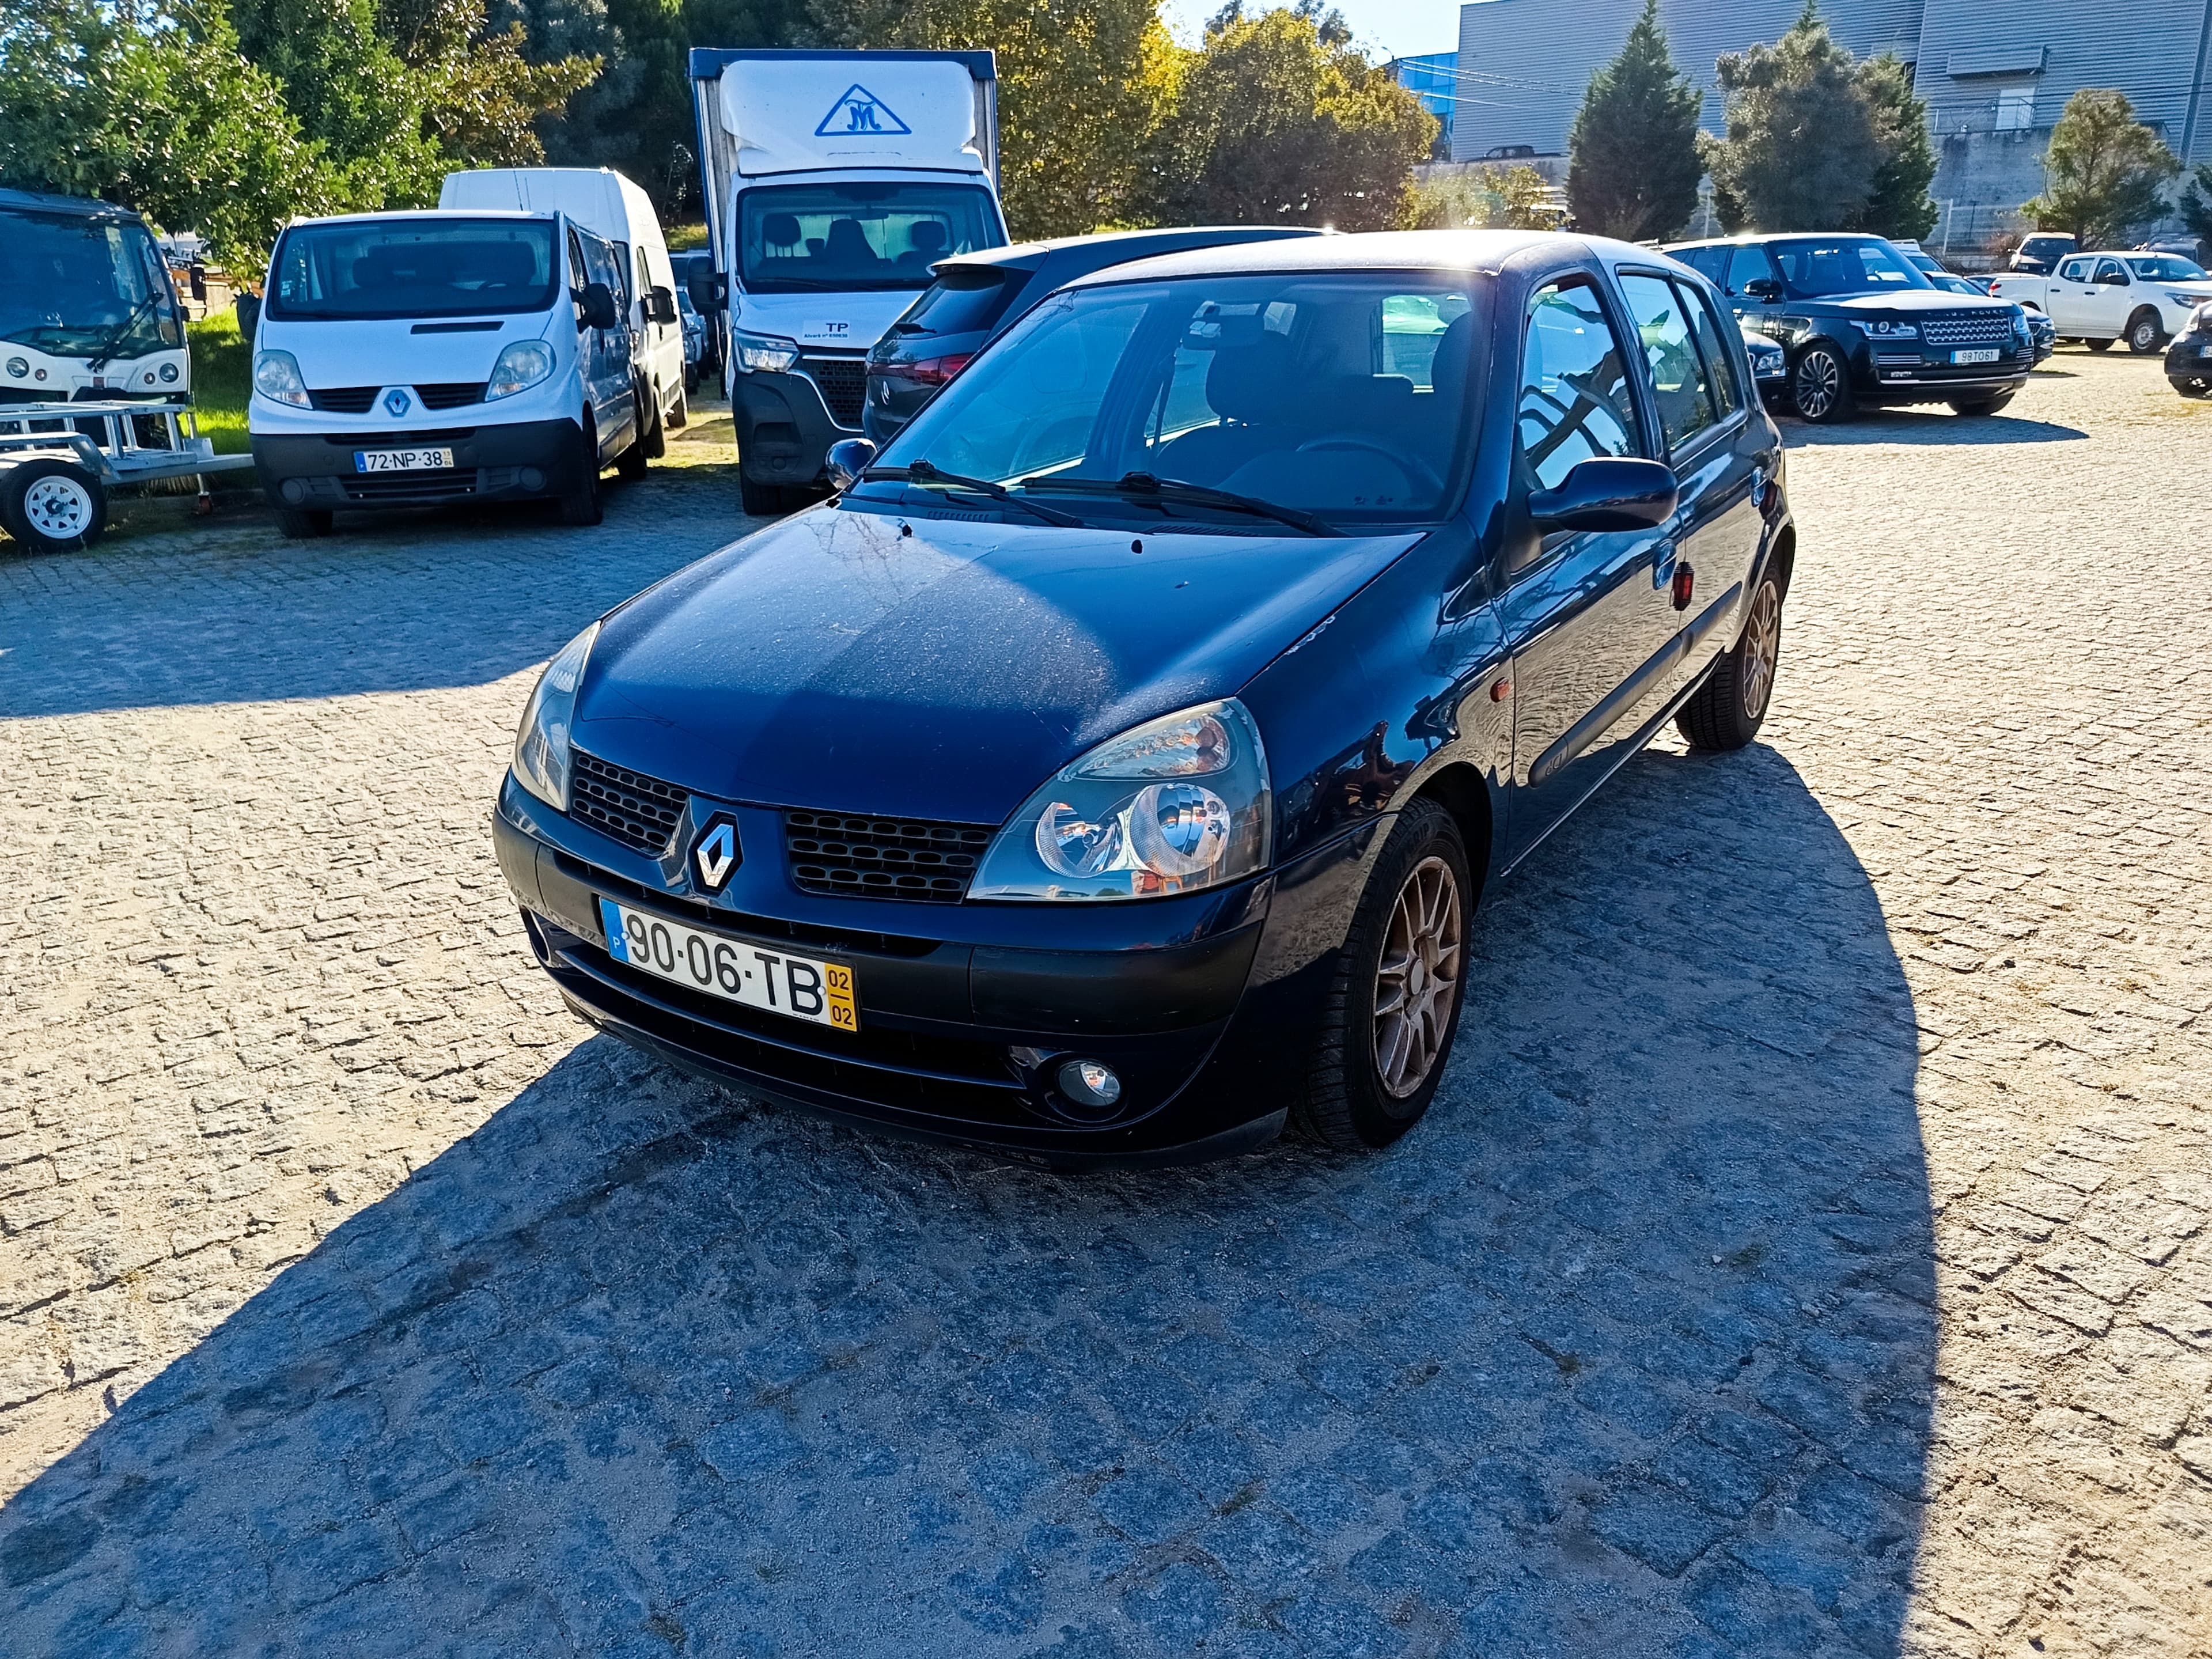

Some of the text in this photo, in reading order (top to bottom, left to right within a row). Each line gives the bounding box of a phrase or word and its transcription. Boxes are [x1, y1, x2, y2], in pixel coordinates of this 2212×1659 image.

[825, 323, 849, 332] TP
[612, 936, 621, 949] P
[828, 969, 850, 991] 02
[831, 1005, 853, 1026] 02
